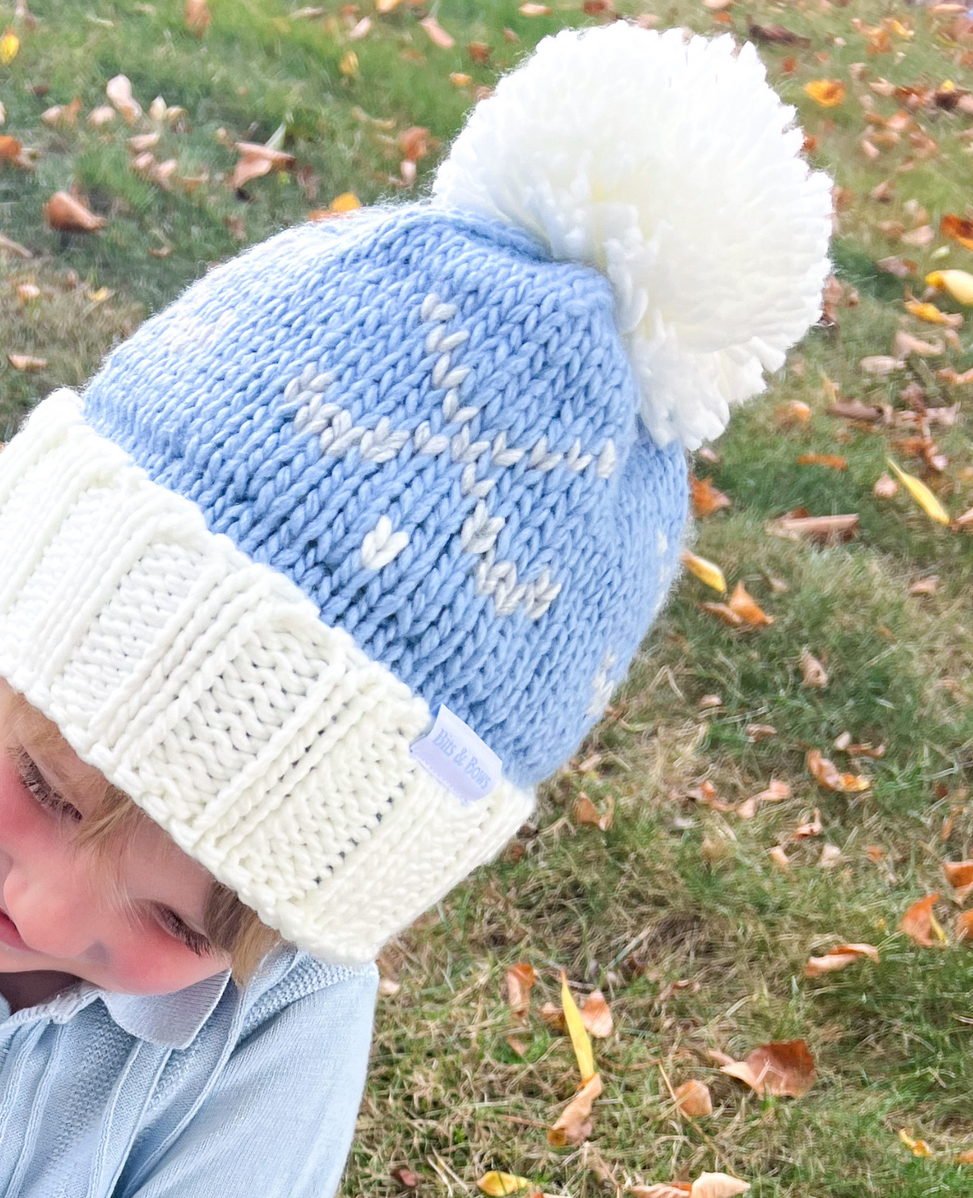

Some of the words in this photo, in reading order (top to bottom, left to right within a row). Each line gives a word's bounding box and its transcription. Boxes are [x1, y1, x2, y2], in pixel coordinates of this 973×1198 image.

[432, 727, 457, 757] Bits
[453, 747, 468, 766] &
[465, 755, 491, 789] Bows
